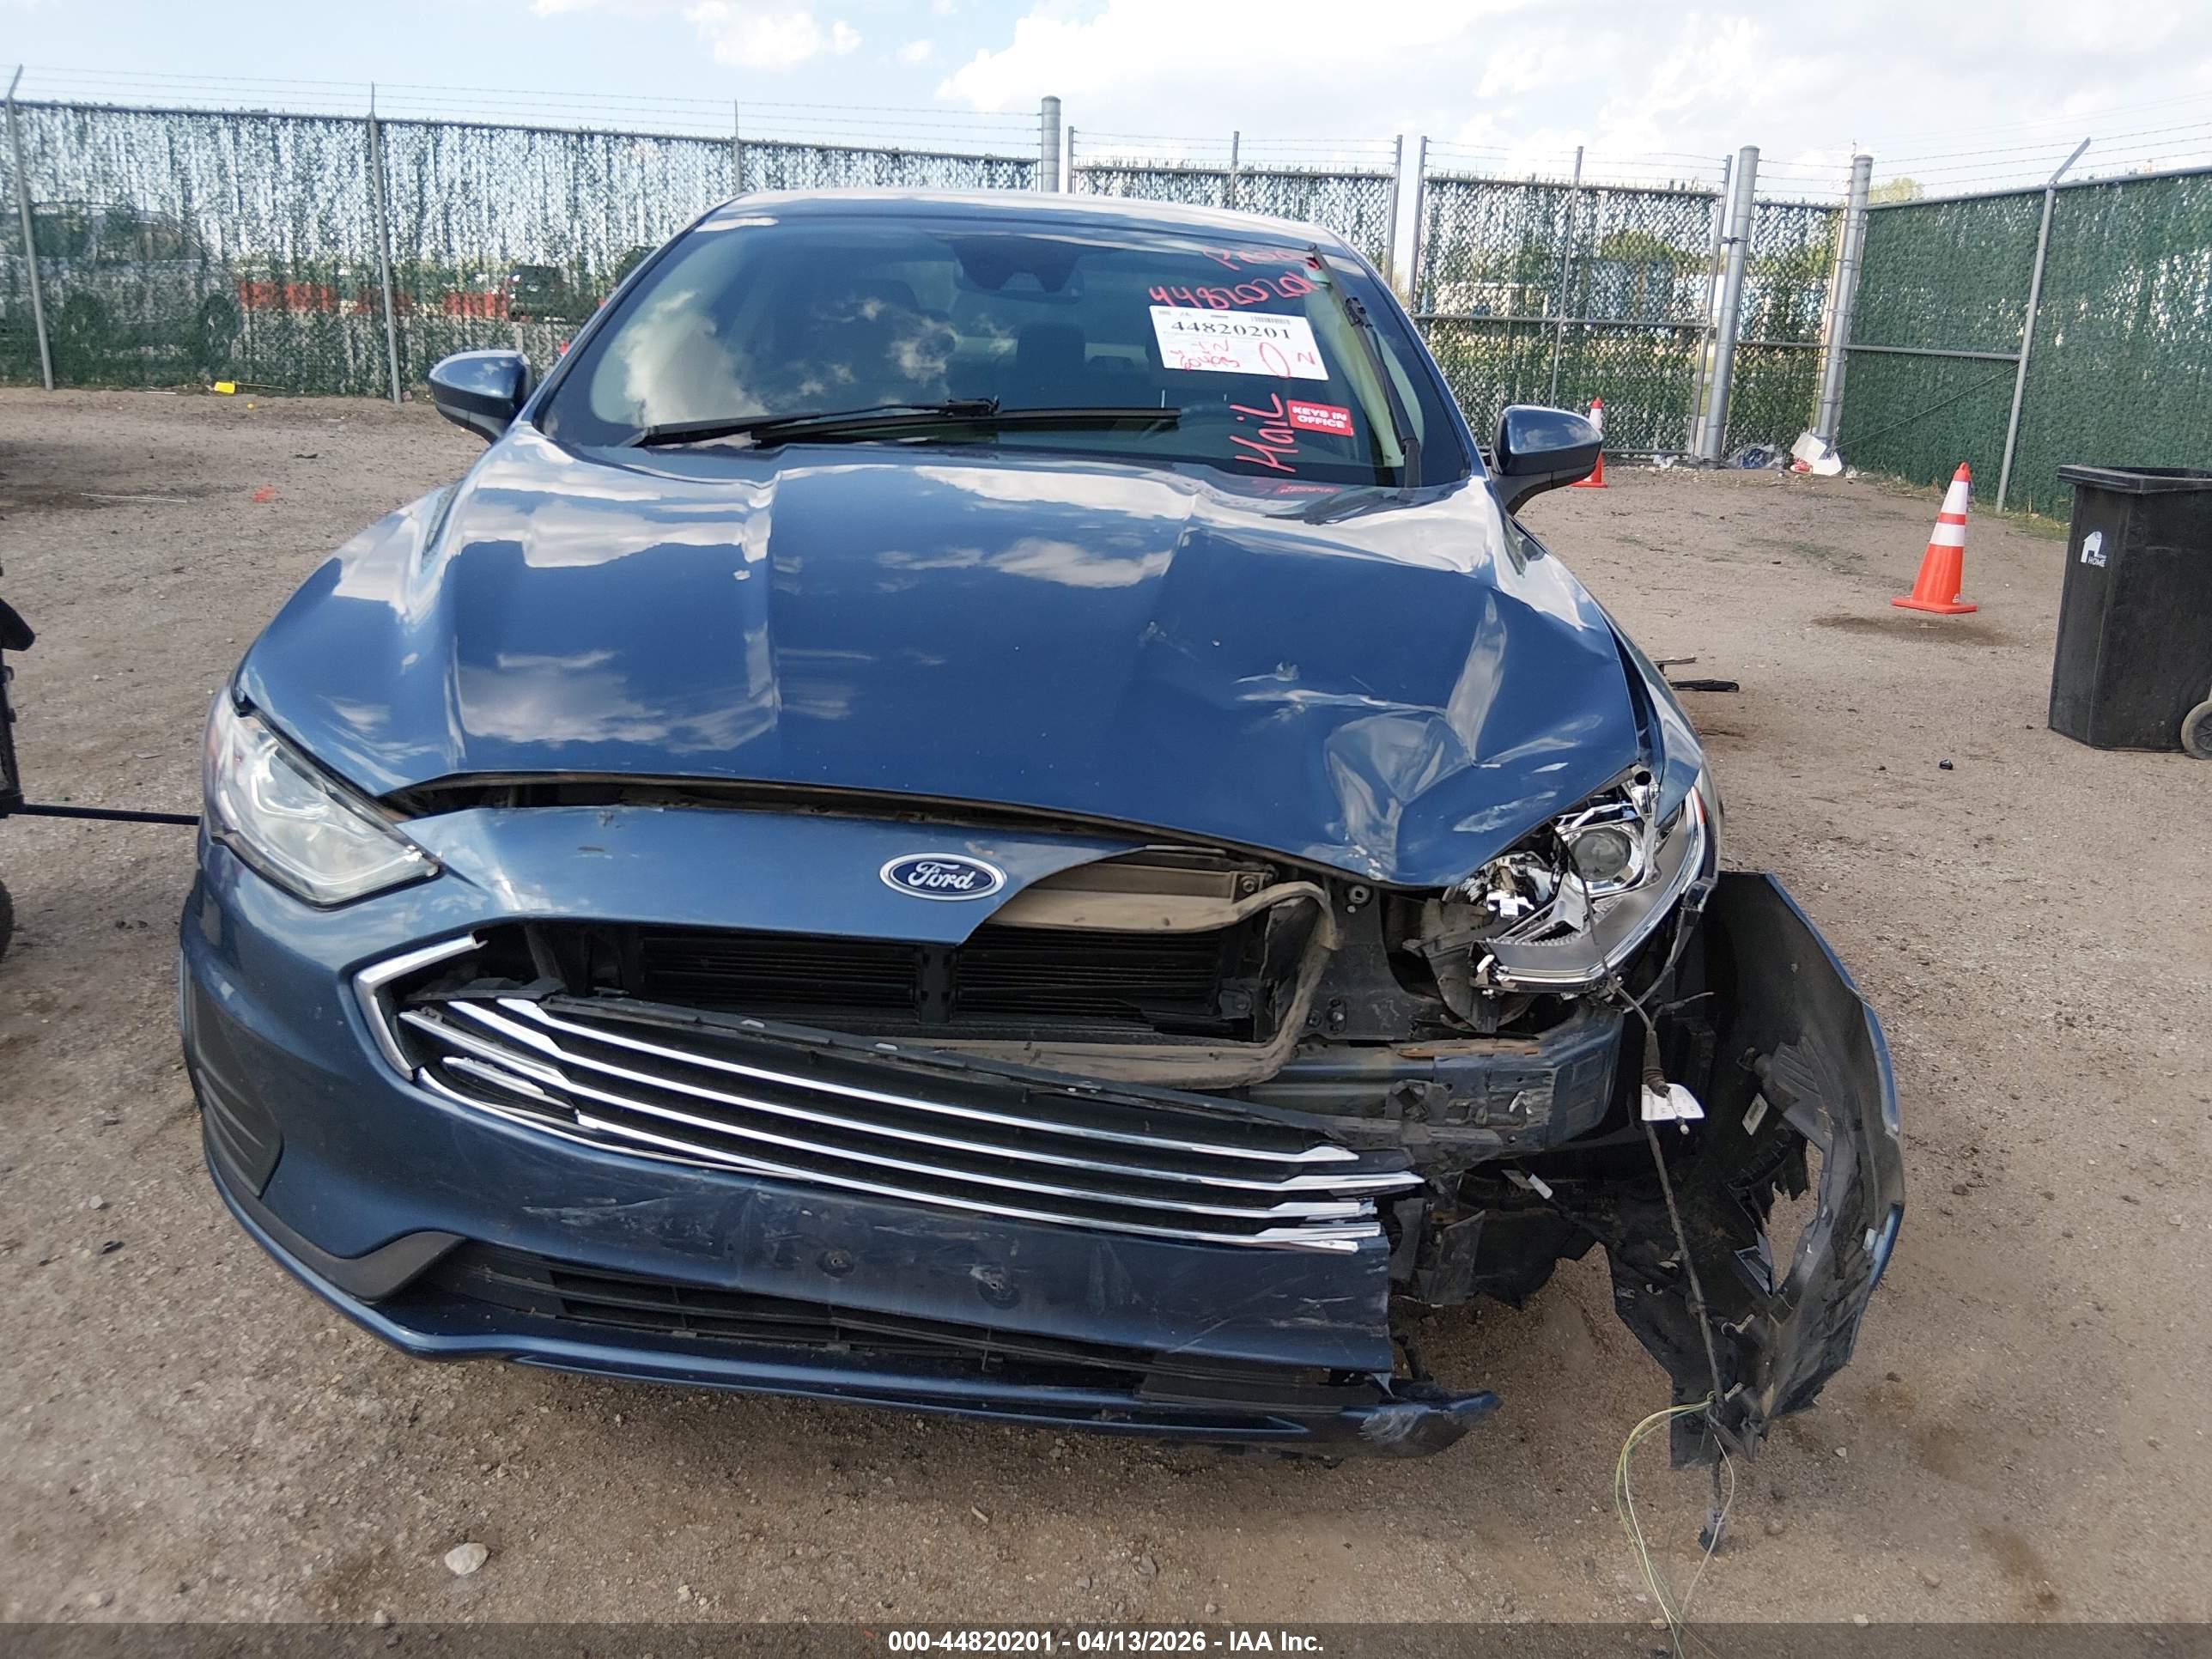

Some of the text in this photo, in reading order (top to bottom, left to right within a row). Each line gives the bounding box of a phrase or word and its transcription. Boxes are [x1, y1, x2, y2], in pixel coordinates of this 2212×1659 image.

[1170, 320, 1291, 340] 44820201
[1291, 405, 1347, 422] KEYS IN
[1297, 415, 1346, 429] OFFICE
[907, 860, 975, 890] Ford
